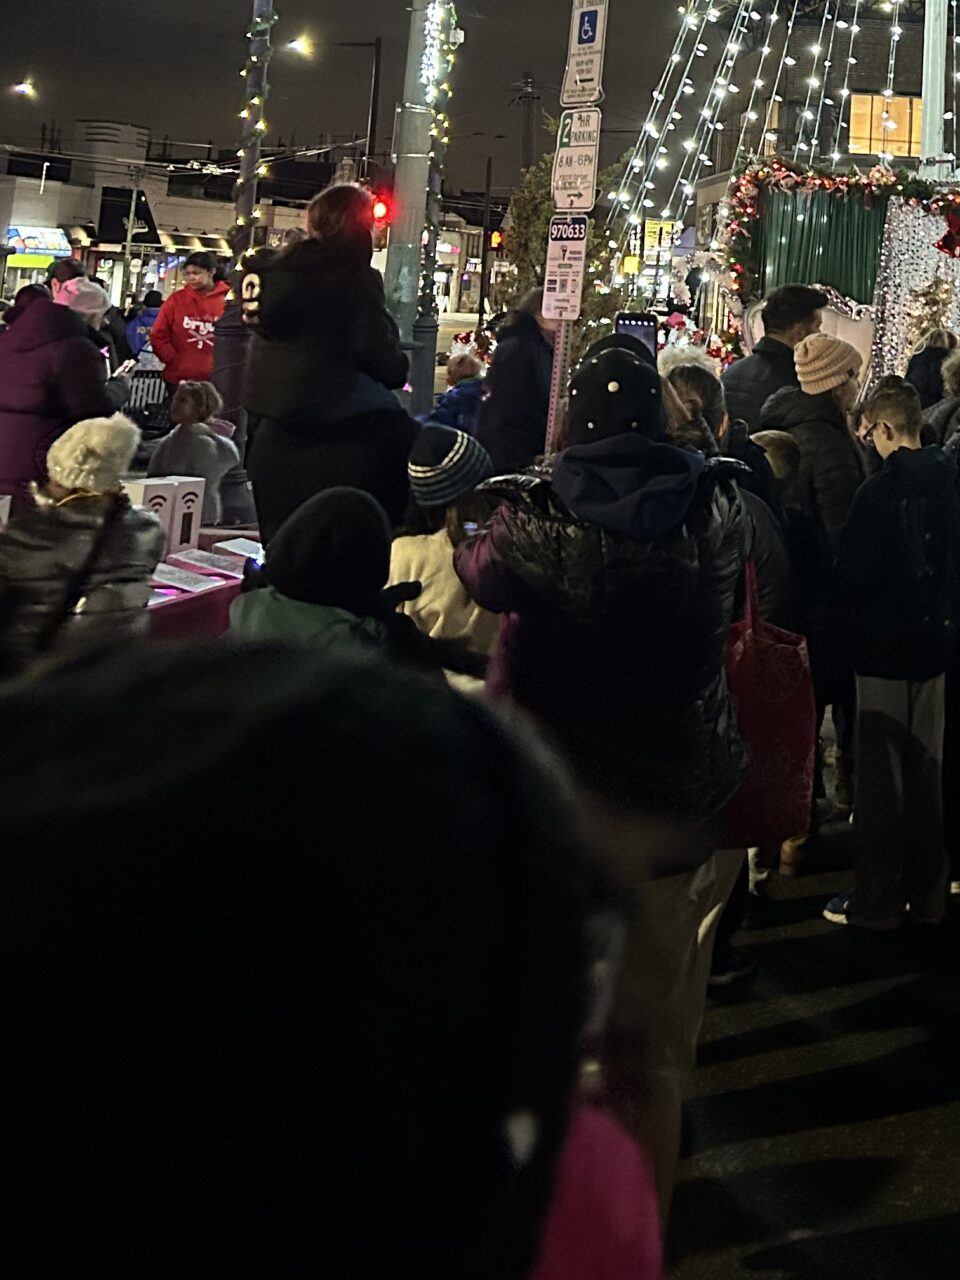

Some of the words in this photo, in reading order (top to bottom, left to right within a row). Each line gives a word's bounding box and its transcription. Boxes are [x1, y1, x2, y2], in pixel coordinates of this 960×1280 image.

[579, 115, 591, 128] HR
[562, 118, 572, 143] 2
[571, 130, 597, 144] PARKING
[551, 223, 585, 239] 970633
